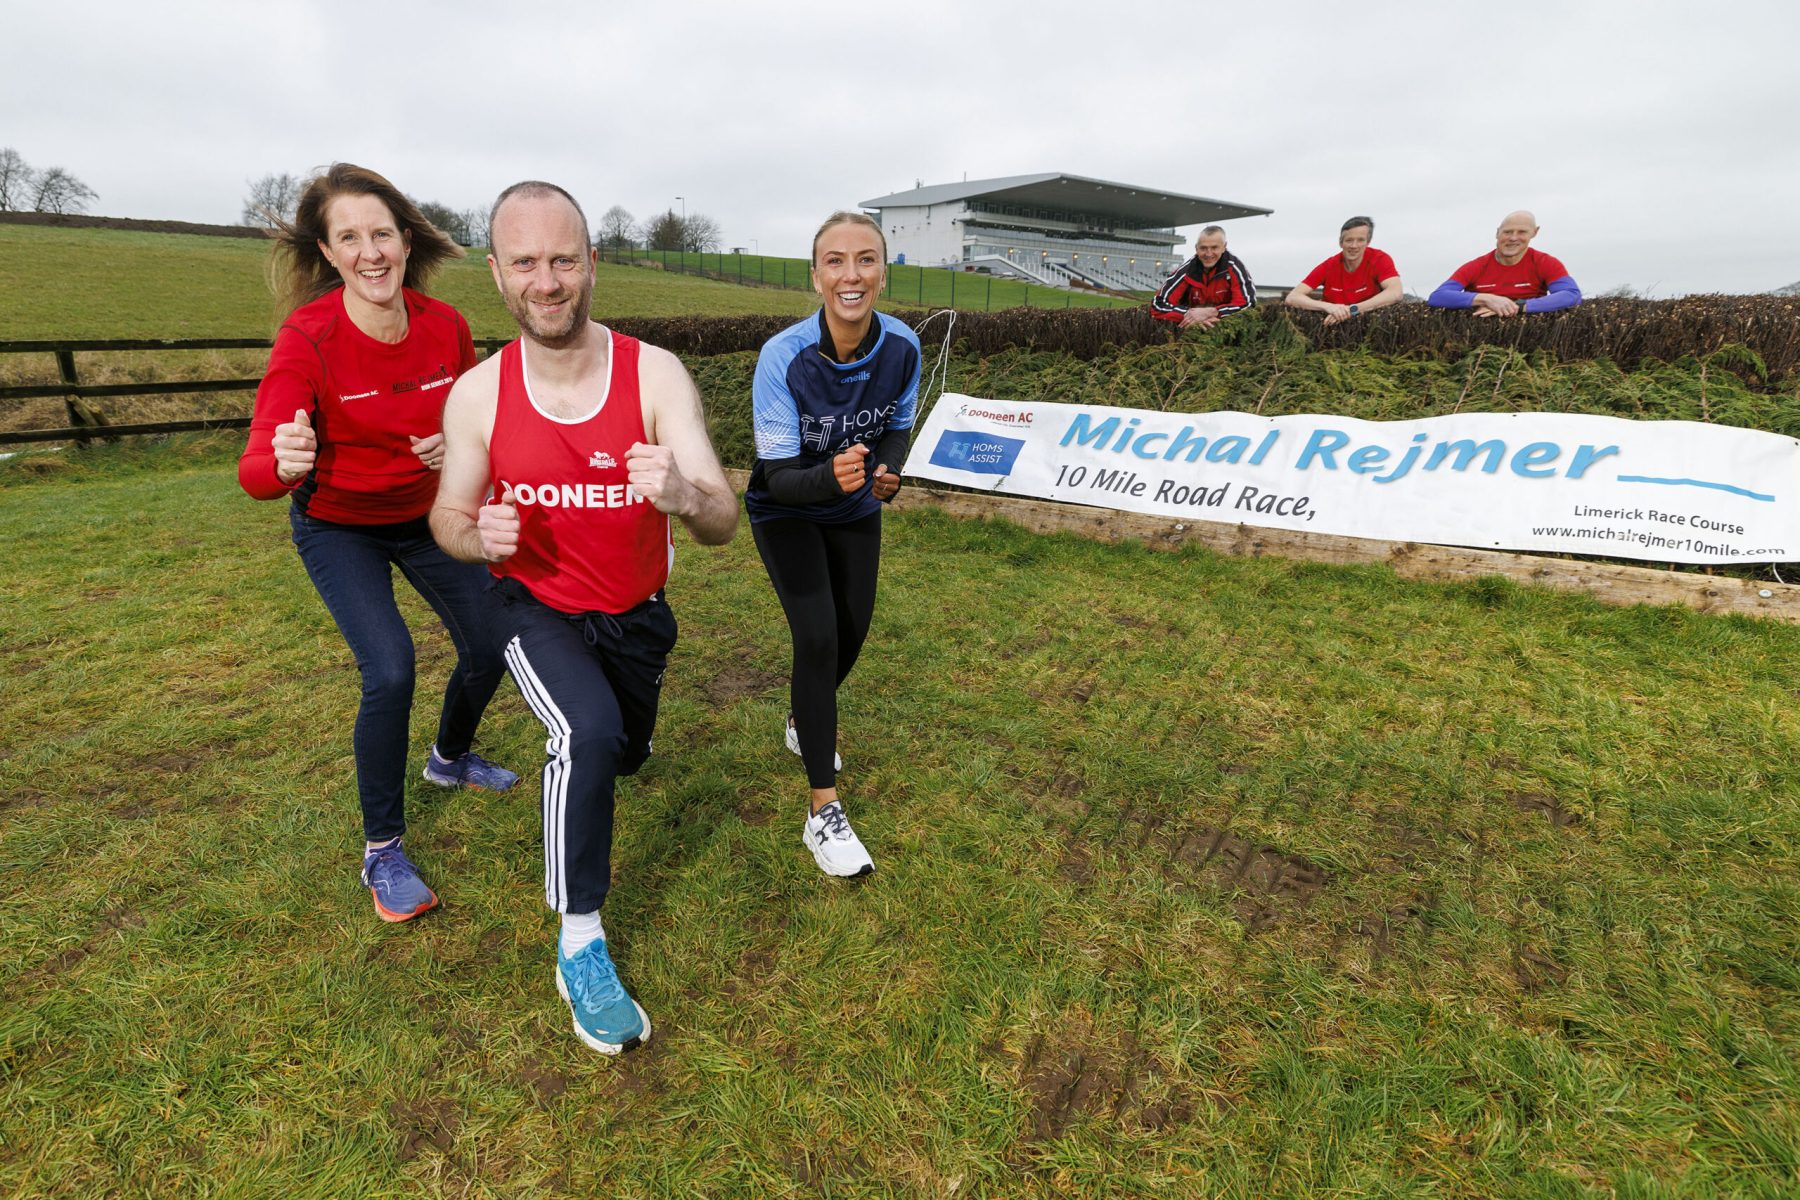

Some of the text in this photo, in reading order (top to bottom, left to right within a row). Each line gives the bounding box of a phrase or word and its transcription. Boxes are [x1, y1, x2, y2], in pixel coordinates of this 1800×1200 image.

[968, 409, 1034, 423] Dooneen AC
[968, 454, 1002, 464] ASSIST
[972, 443, 1004, 453] HOMS
[1058, 413, 1620, 484] Michal Rejmer
[1055, 464, 1317, 520] 10 Mile Road Race,
[1574, 504, 1745, 536] Limerick Race Course
[1532, 526, 1786, 557] www.michalrejmer10mile.com
